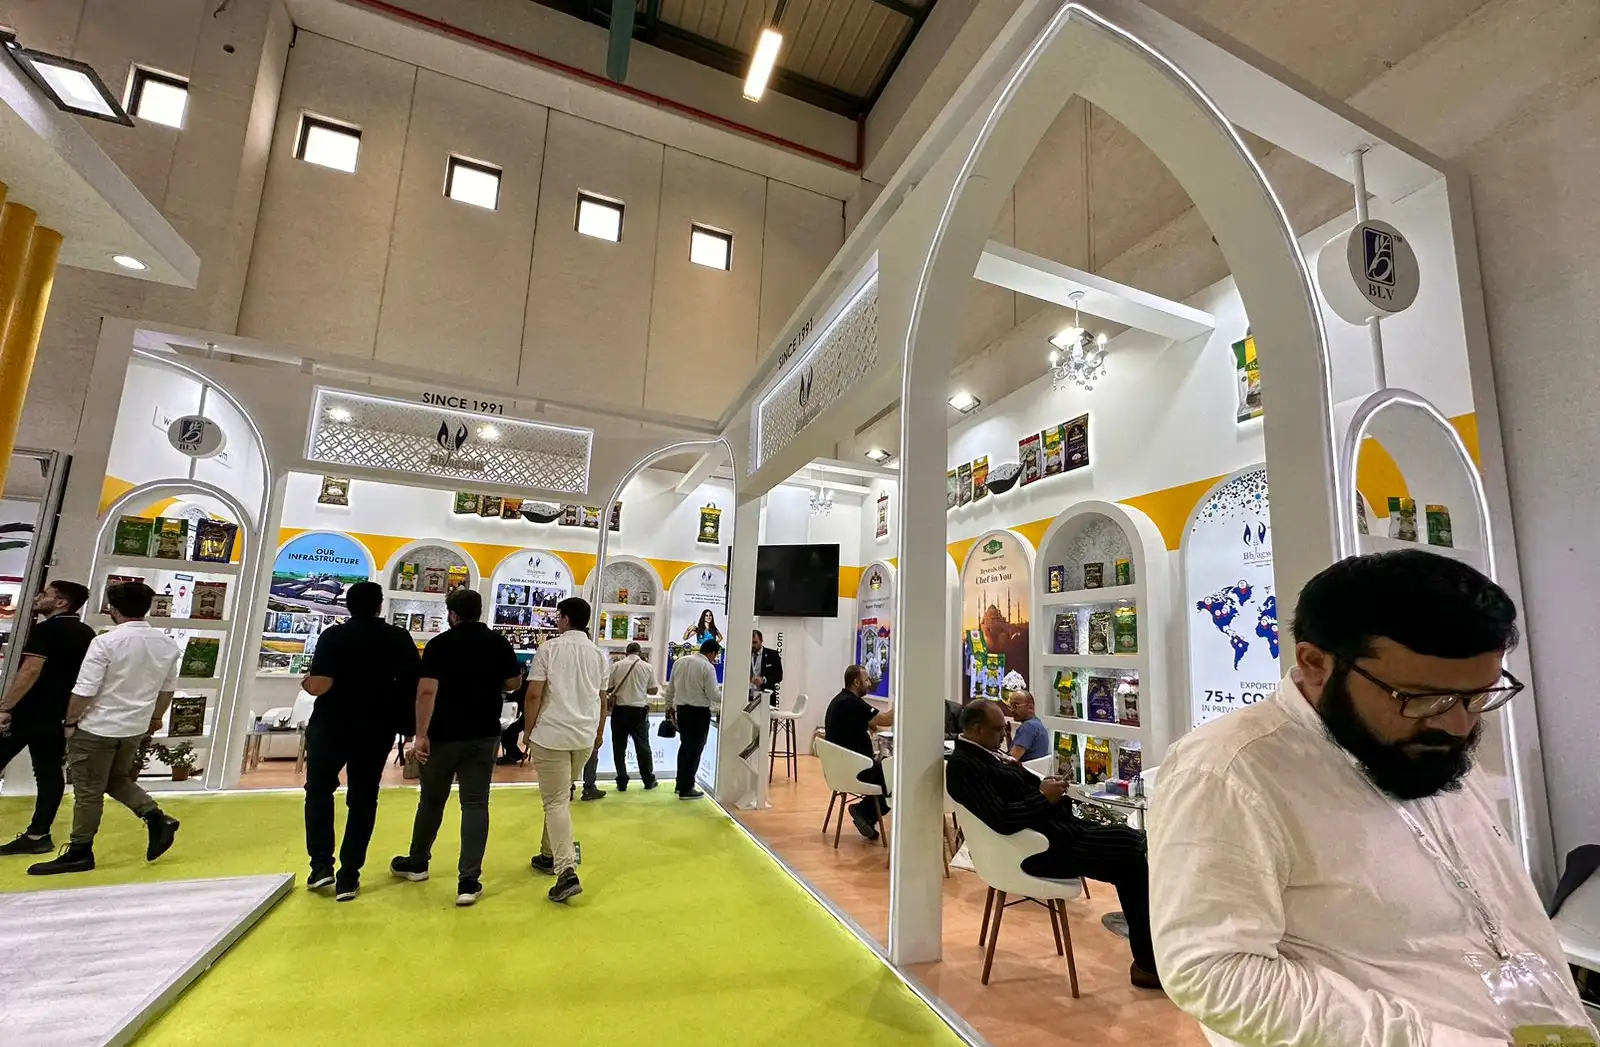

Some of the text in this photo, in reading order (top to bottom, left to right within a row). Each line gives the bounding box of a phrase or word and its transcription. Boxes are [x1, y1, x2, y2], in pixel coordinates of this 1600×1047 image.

[1368, 283, 1395, 301] BLV
[778, 316, 813, 370] SINCE 1991
[422, 392, 504, 415] SINCE 1991
[316, 548, 335, 556] OUR
[1243, 550, 1272, 561] Bhagw
[288, 553, 360, 565] INFRASTRUCTURE
[1000, 573, 1012, 581] You
[1240, 681, 1276, 690] EXPORTI
[1204, 690, 1265, 705] 75+ CO
[1201, 704, 1211, 712] IN
